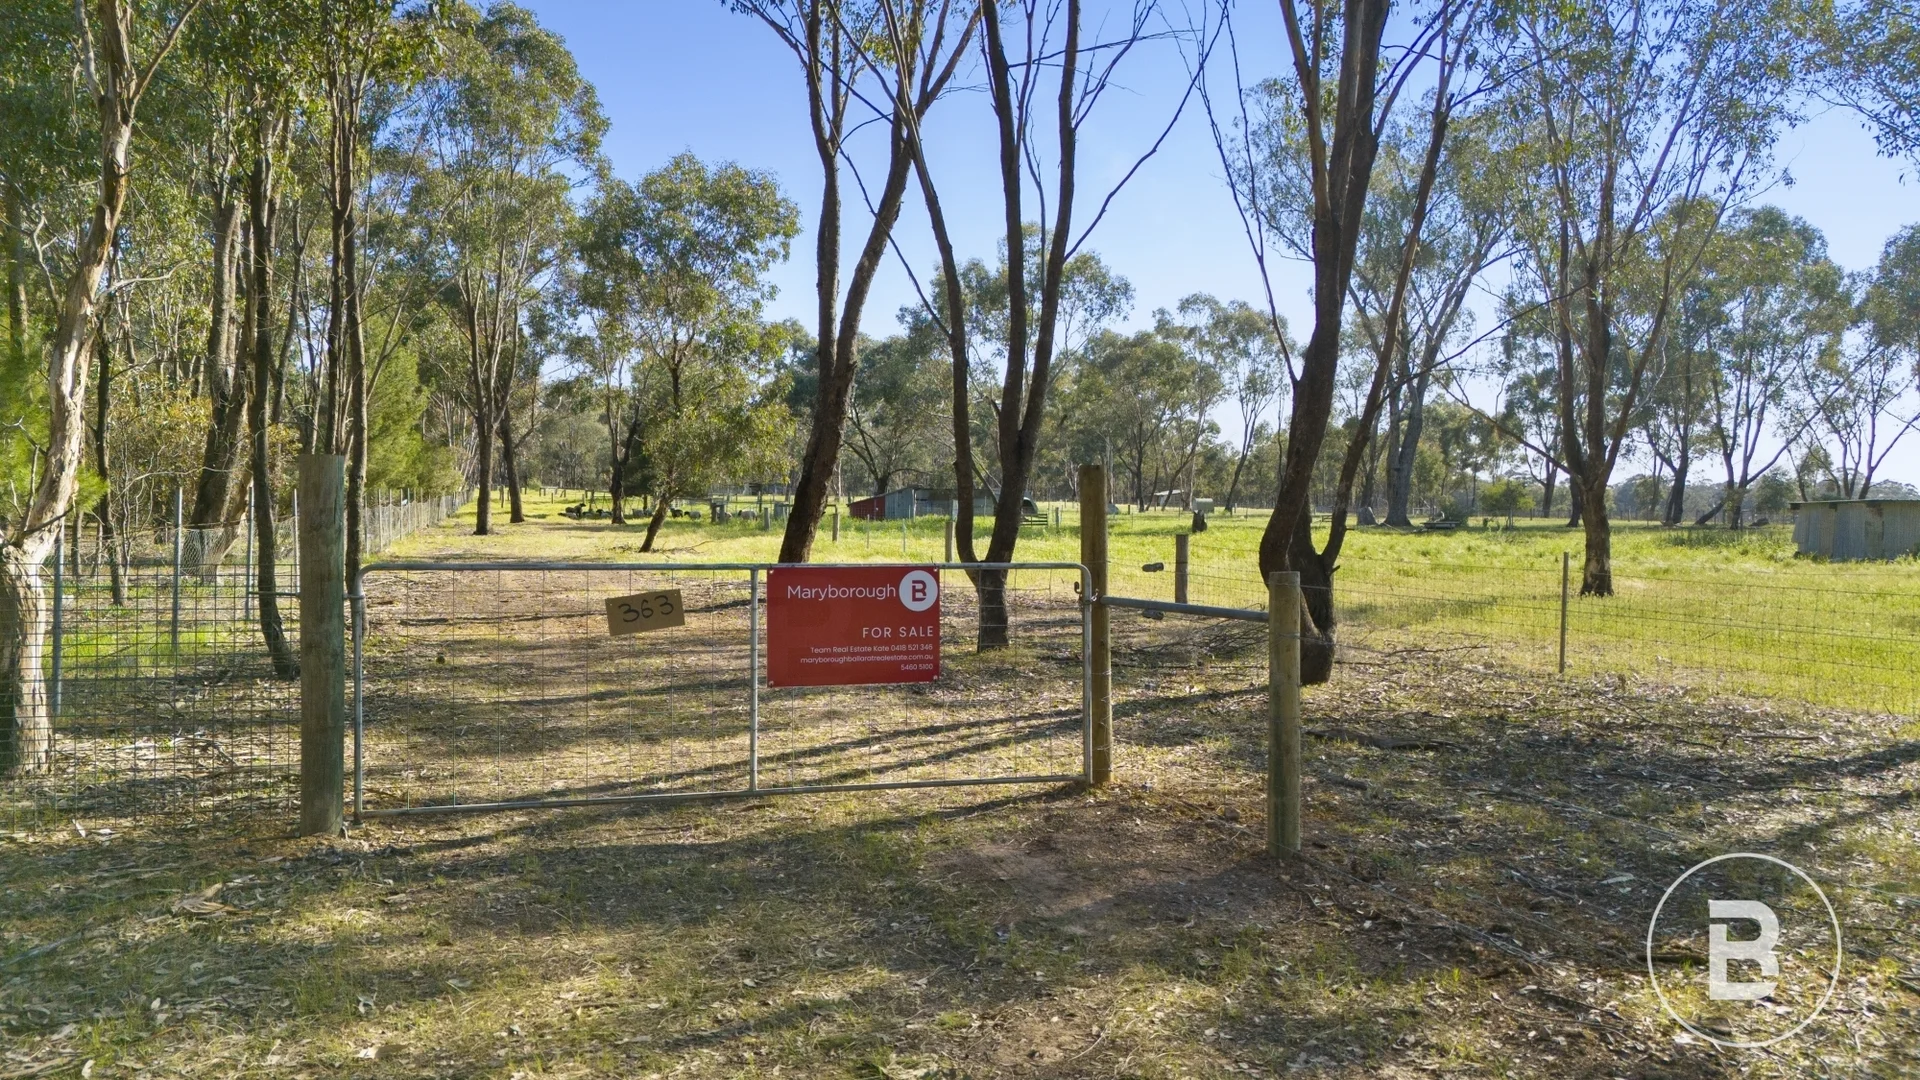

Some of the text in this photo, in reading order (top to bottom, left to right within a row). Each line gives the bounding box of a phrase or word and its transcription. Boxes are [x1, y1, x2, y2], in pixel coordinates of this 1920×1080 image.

[787, 580, 927, 602] Maryborough B
[618, 595, 674, 622] 363
[862, 626, 934, 638] FOR SALE
[849, 645, 872, 653] Estate
[800, 654, 934, 664] maryboroughballaratrealestate.com.au
